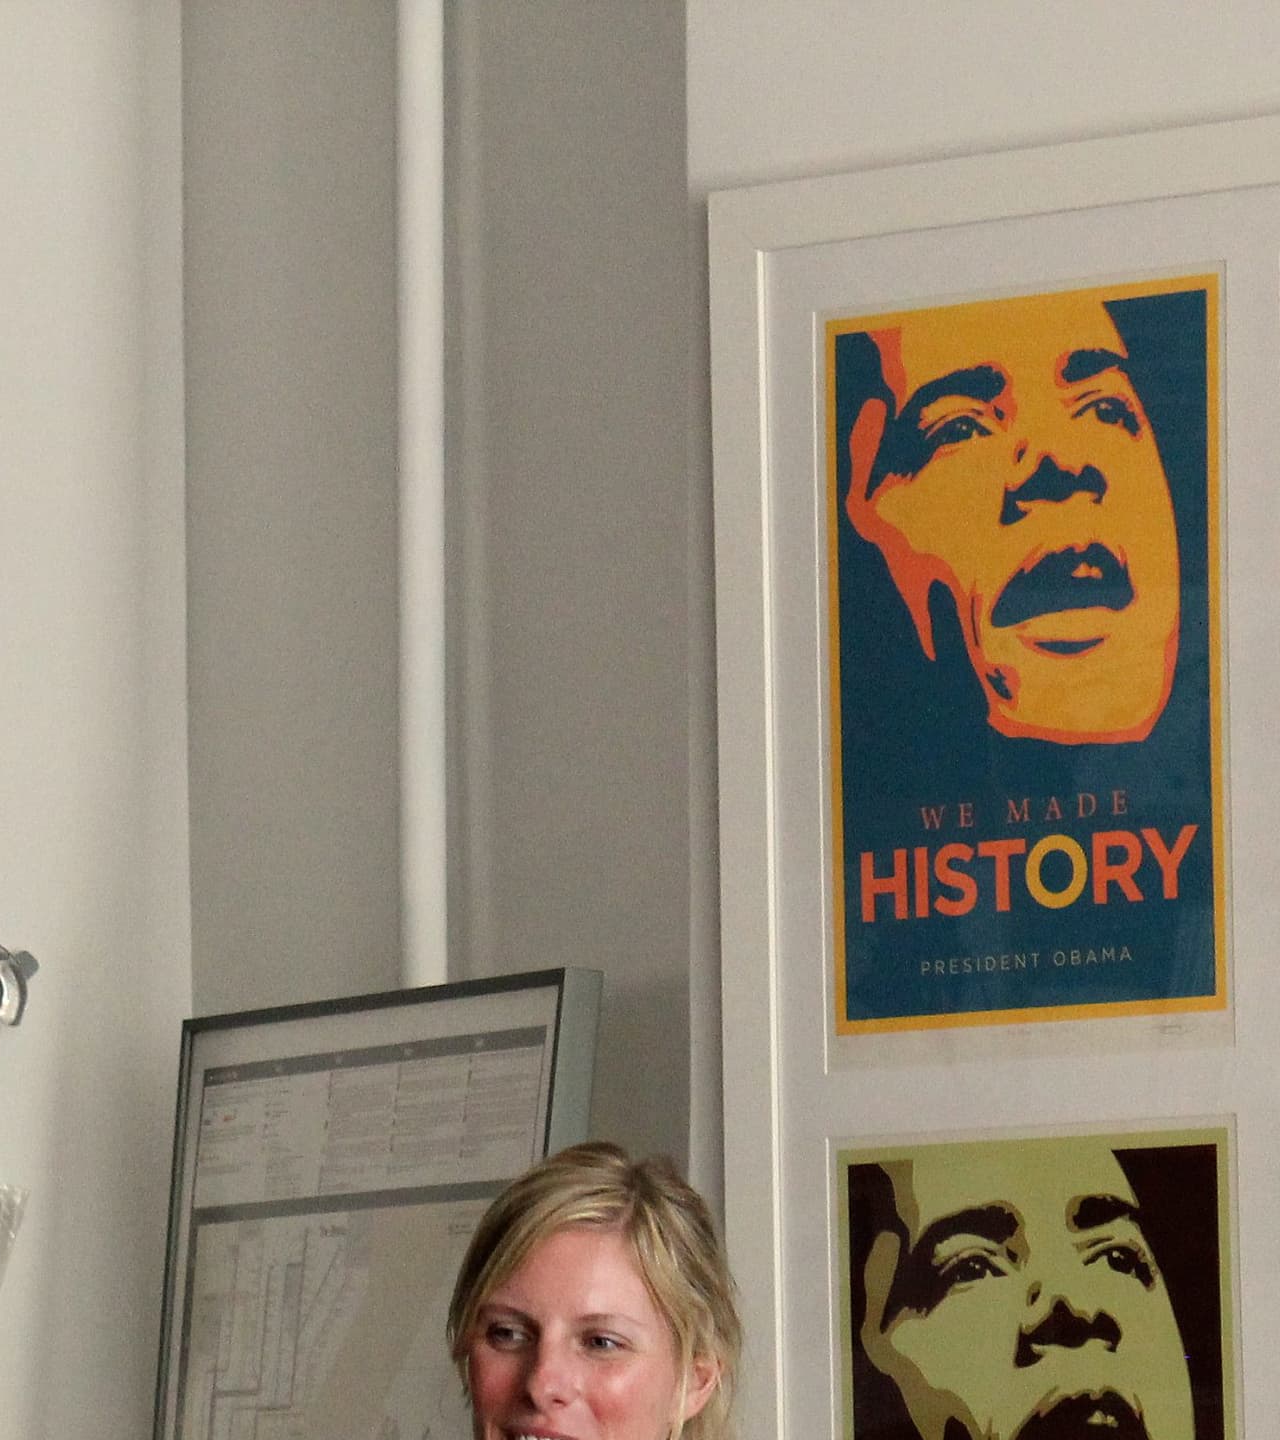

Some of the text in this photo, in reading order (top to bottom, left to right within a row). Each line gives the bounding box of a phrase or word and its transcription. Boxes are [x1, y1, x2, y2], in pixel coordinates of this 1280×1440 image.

[921, 789, 1130, 831] WE MADE
[859, 823, 1201, 924] HISTORY
[920, 945, 1133, 977] PRESIDENT OBAMA
